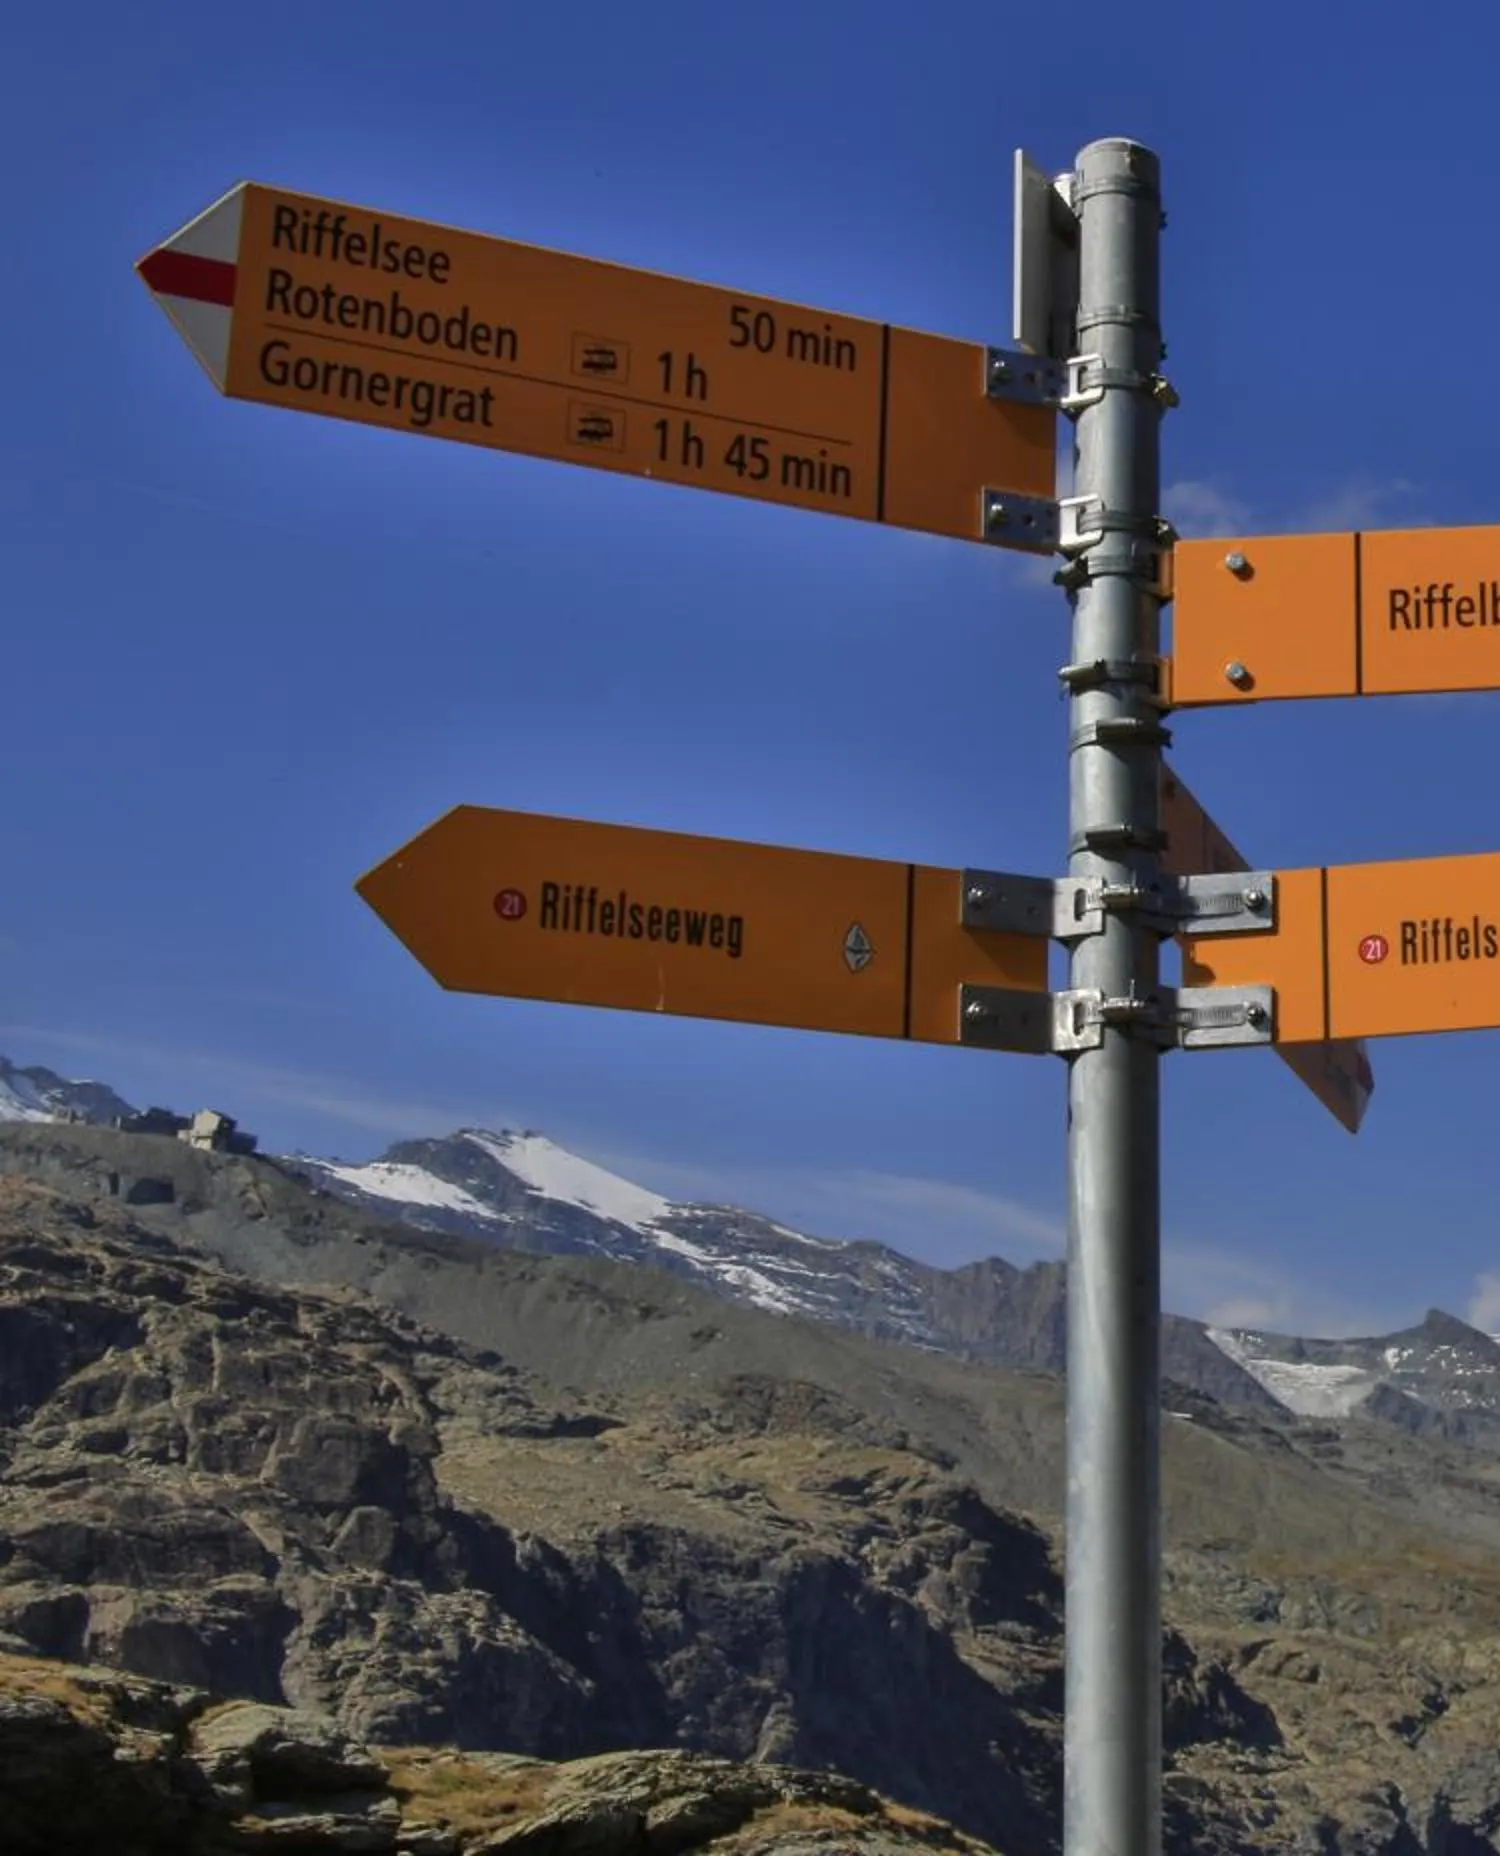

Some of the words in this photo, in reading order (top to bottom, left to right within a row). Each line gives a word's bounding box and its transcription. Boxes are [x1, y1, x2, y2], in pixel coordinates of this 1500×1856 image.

[264, 267, 519, 362] Rotenboden
[272, 203, 451, 285] Riffelsee
[729, 304, 777, 354] 50
[786, 323, 857, 372] min
[258, 339, 495, 428] Gornergrat
[723, 434, 771, 481] 45
[781, 448, 852, 498] min
[501, 893, 520, 916] 21
[539, 881, 745, 959] Riffelseeweg
[1365, 939, 1382, 960] 21
